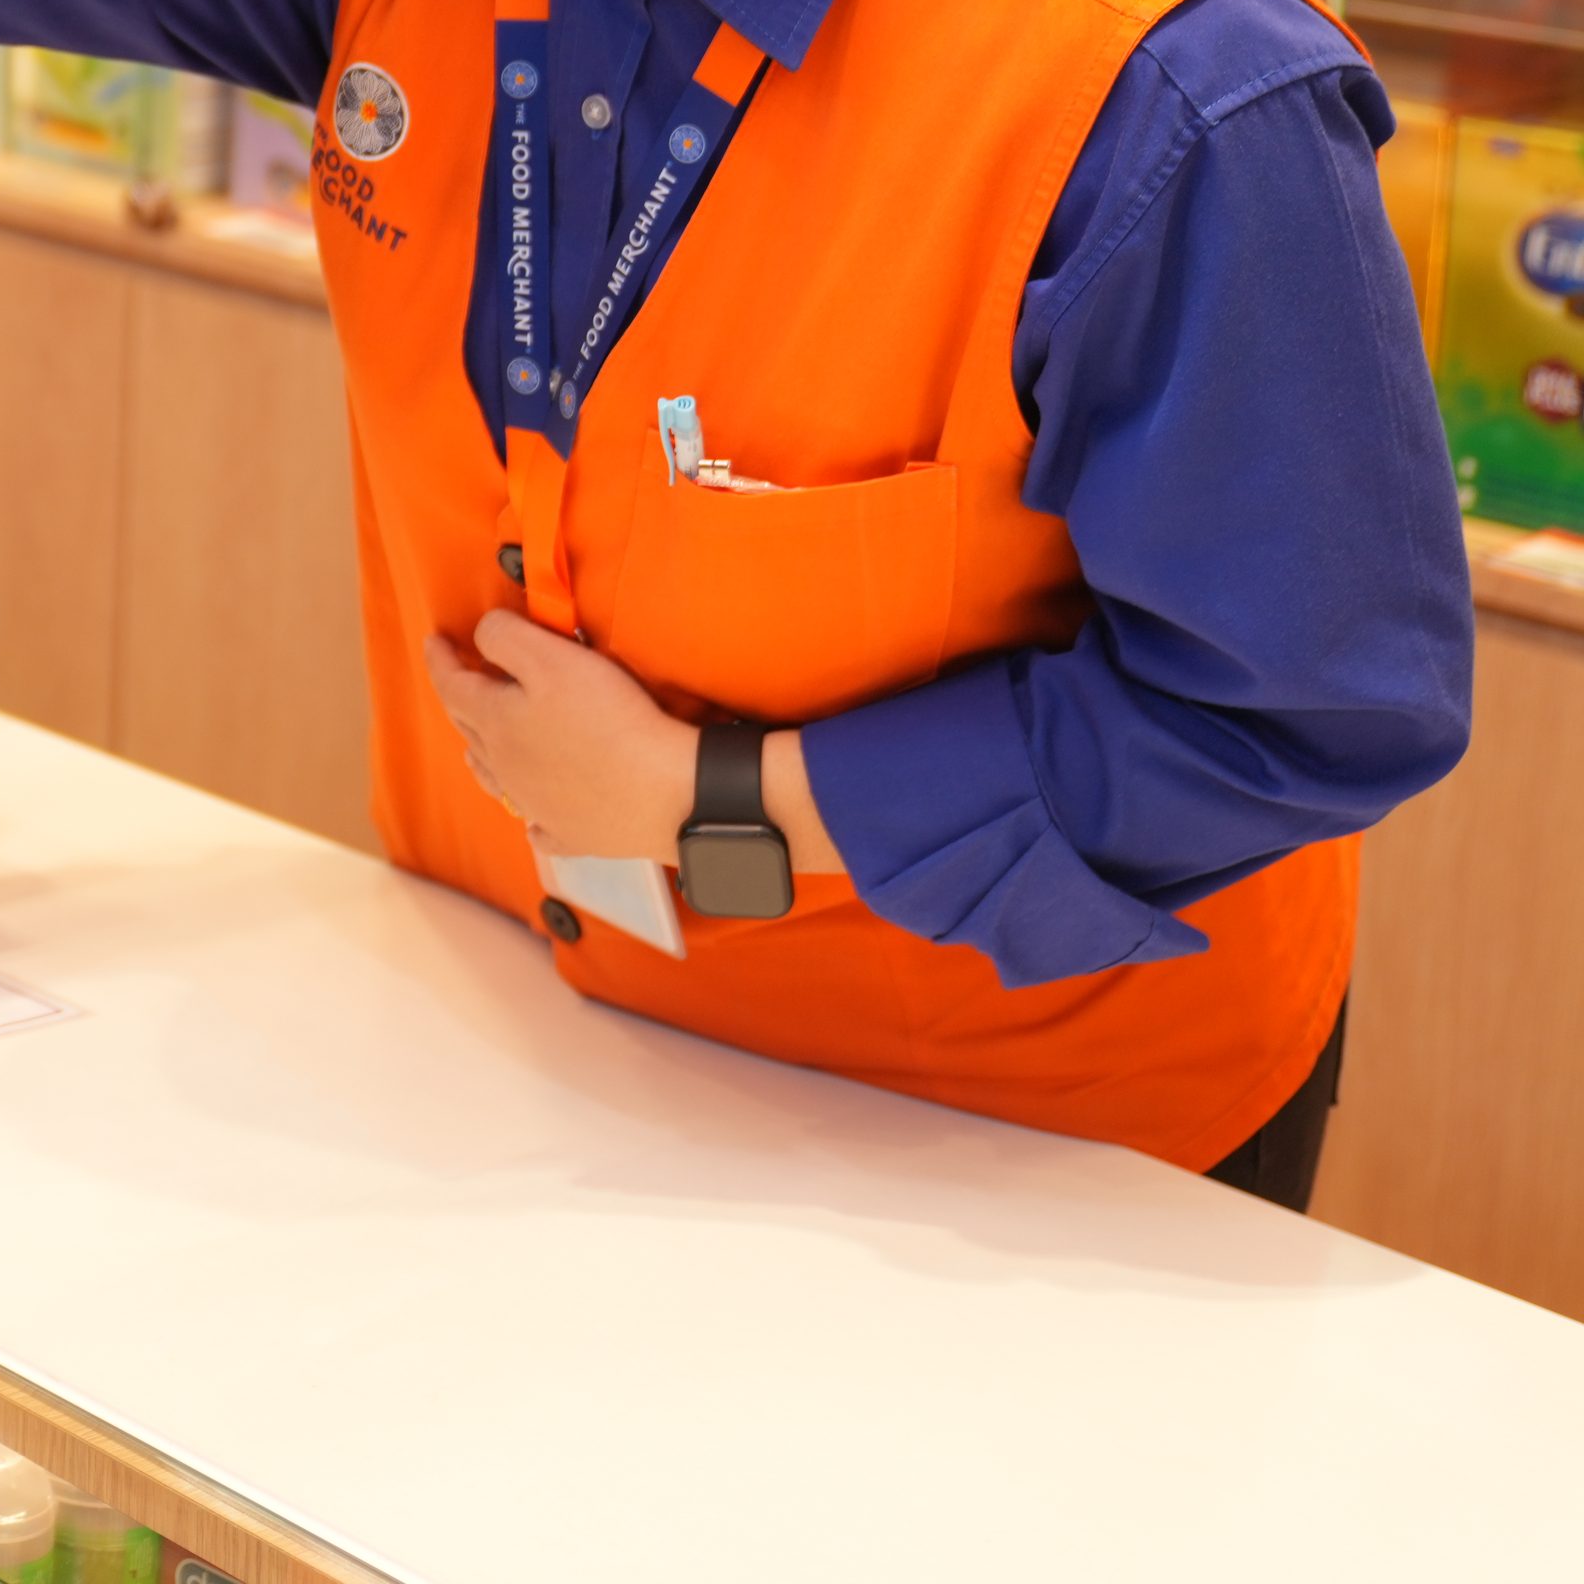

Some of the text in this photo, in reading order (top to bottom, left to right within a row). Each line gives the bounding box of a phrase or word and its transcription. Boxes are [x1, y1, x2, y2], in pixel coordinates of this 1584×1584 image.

[511, 129, 531, 201] FOOD
[507, 206, 533, 347] MERCHANT
[580, 296, 614, 361] FOOD
[607, 167, 678, 296] MERCHANT
